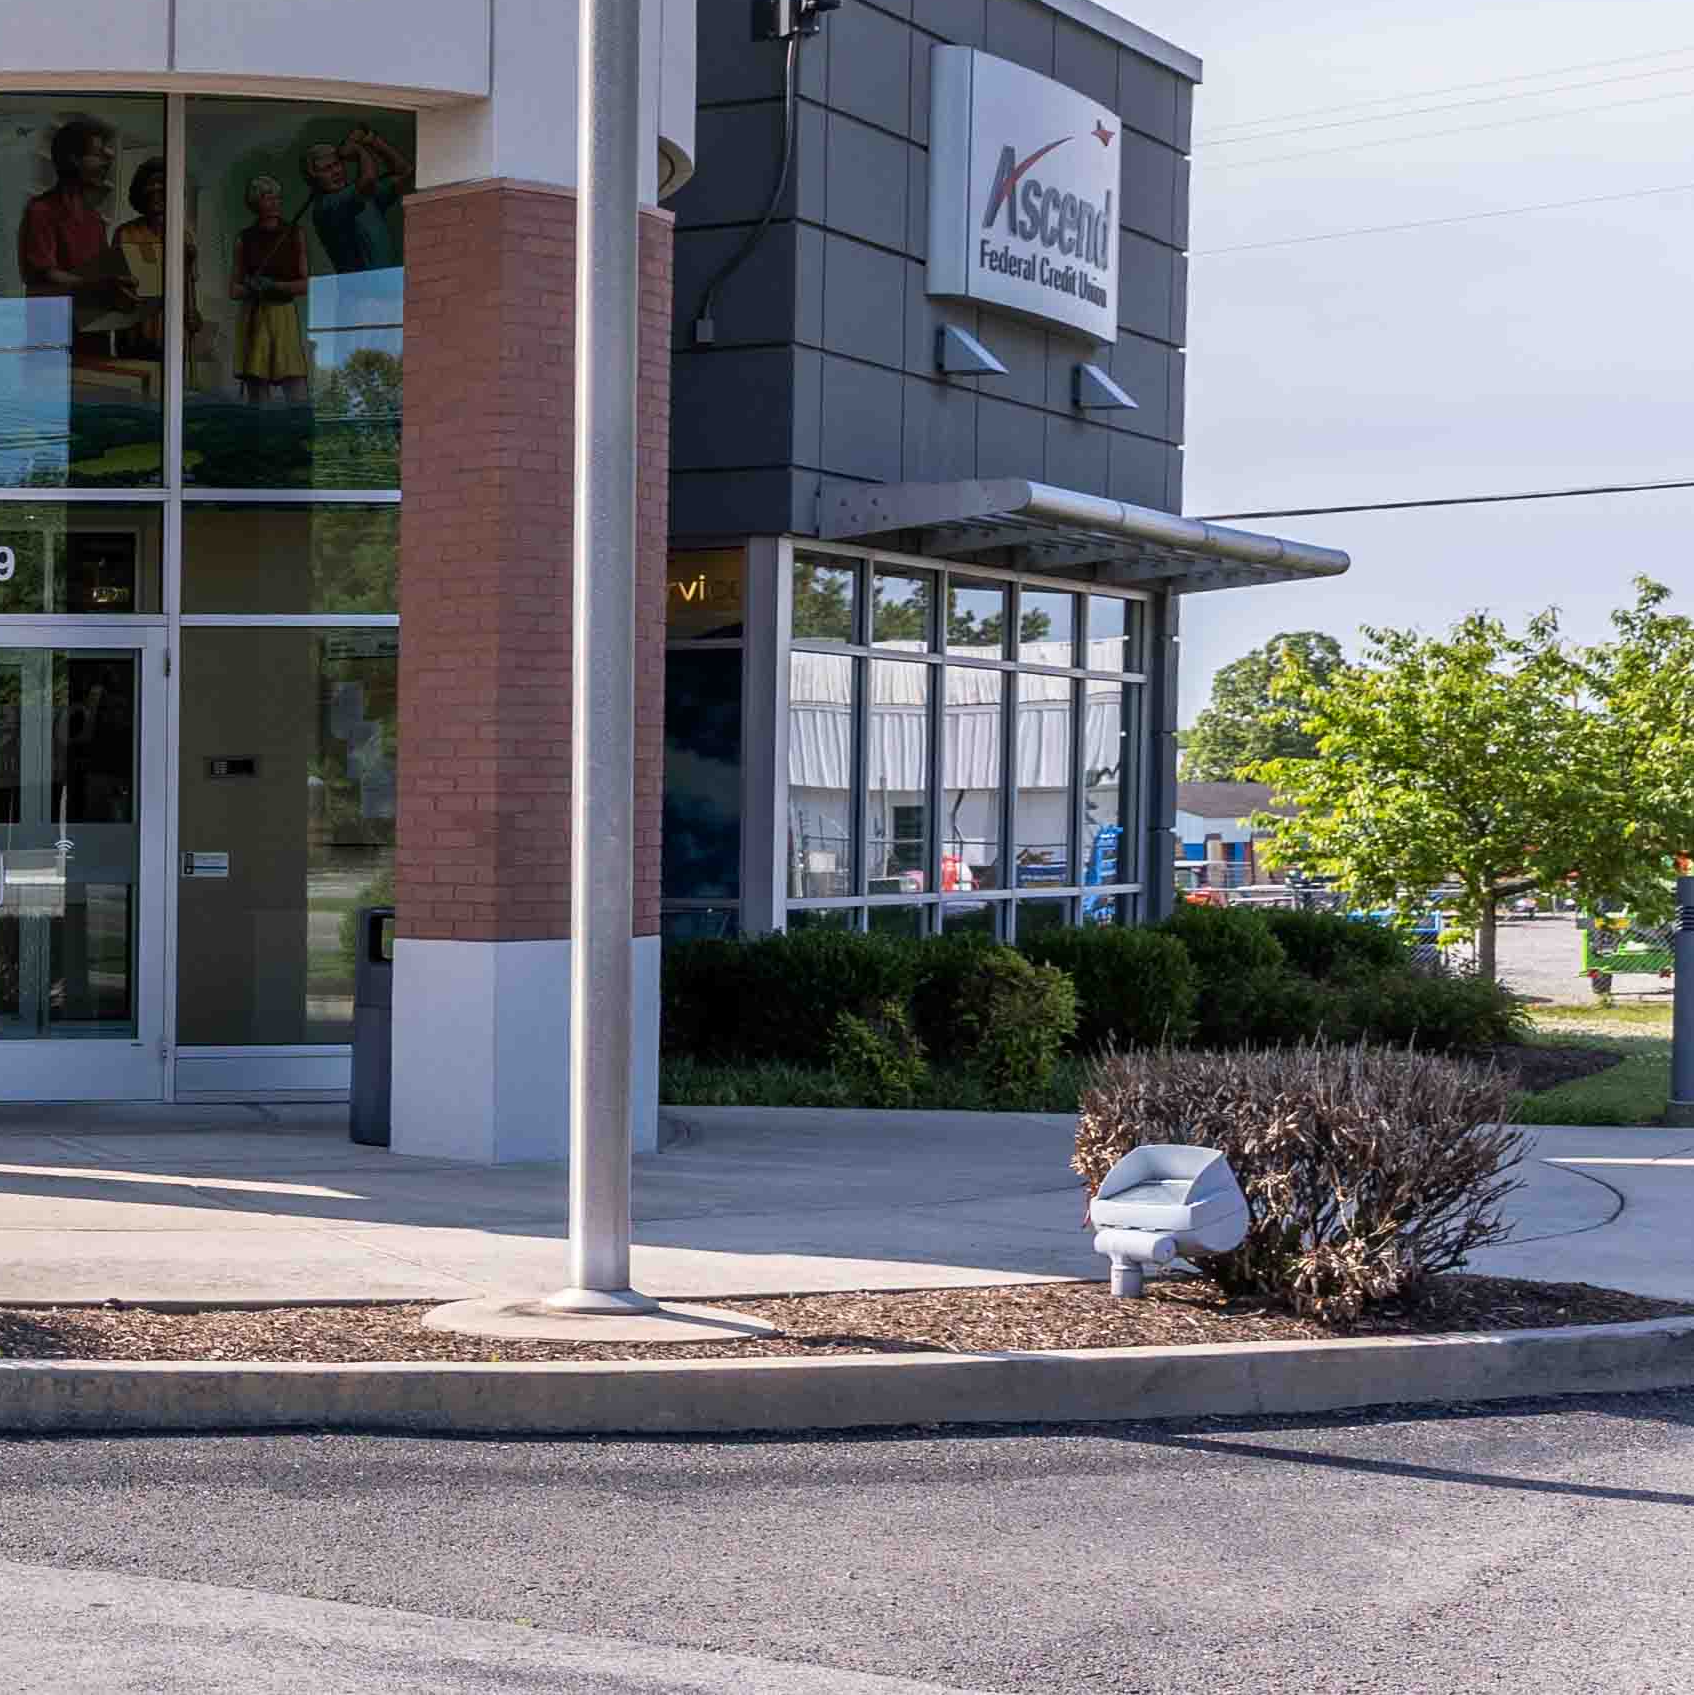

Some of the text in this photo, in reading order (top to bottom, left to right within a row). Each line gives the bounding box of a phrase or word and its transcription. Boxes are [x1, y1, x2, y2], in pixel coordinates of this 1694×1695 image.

[982, 145, 1111, 270] Ascend
[980, 239, 1108, 308] Federal Credit Union
